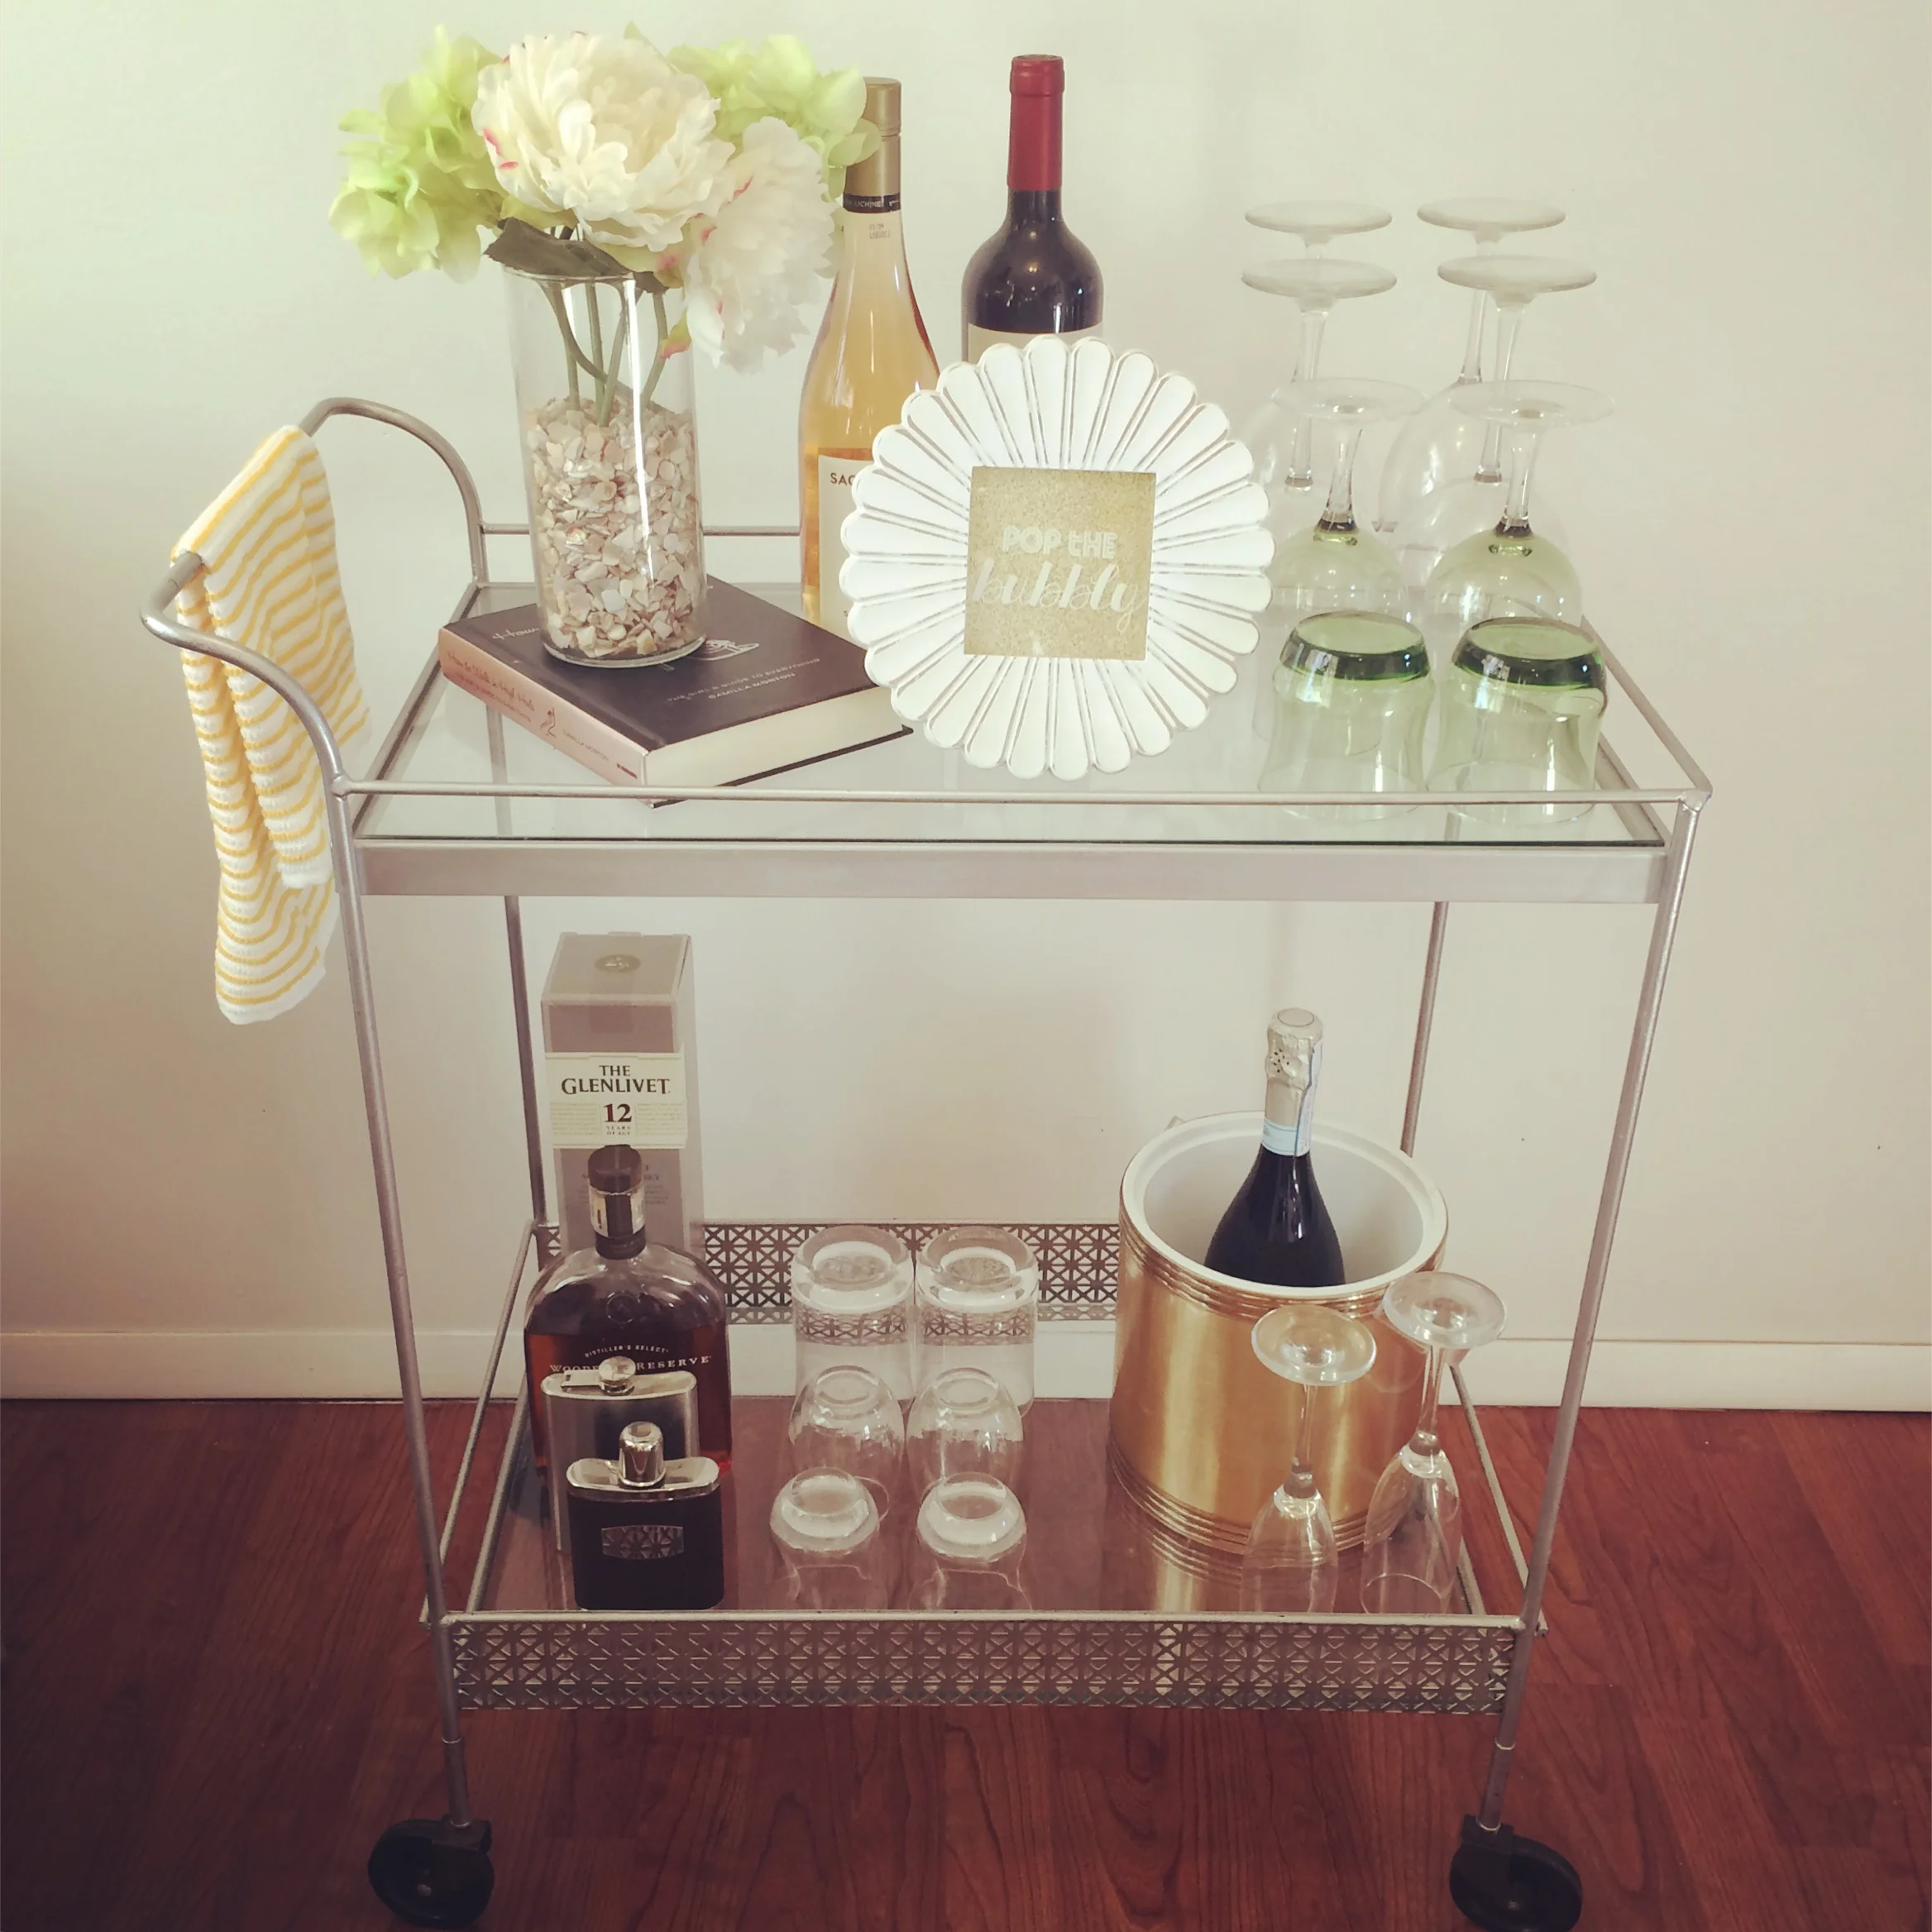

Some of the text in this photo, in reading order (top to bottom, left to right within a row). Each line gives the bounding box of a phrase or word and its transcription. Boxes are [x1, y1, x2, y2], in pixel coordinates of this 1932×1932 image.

[1002, 524, 1061, 555] POP
[971, 557, 1147, 634] bubbly
[599, 1065, 631, 1077] THE
[603, 1103, 633, 1123] 12
[636, 1355, 710, 1370] RESERVE
